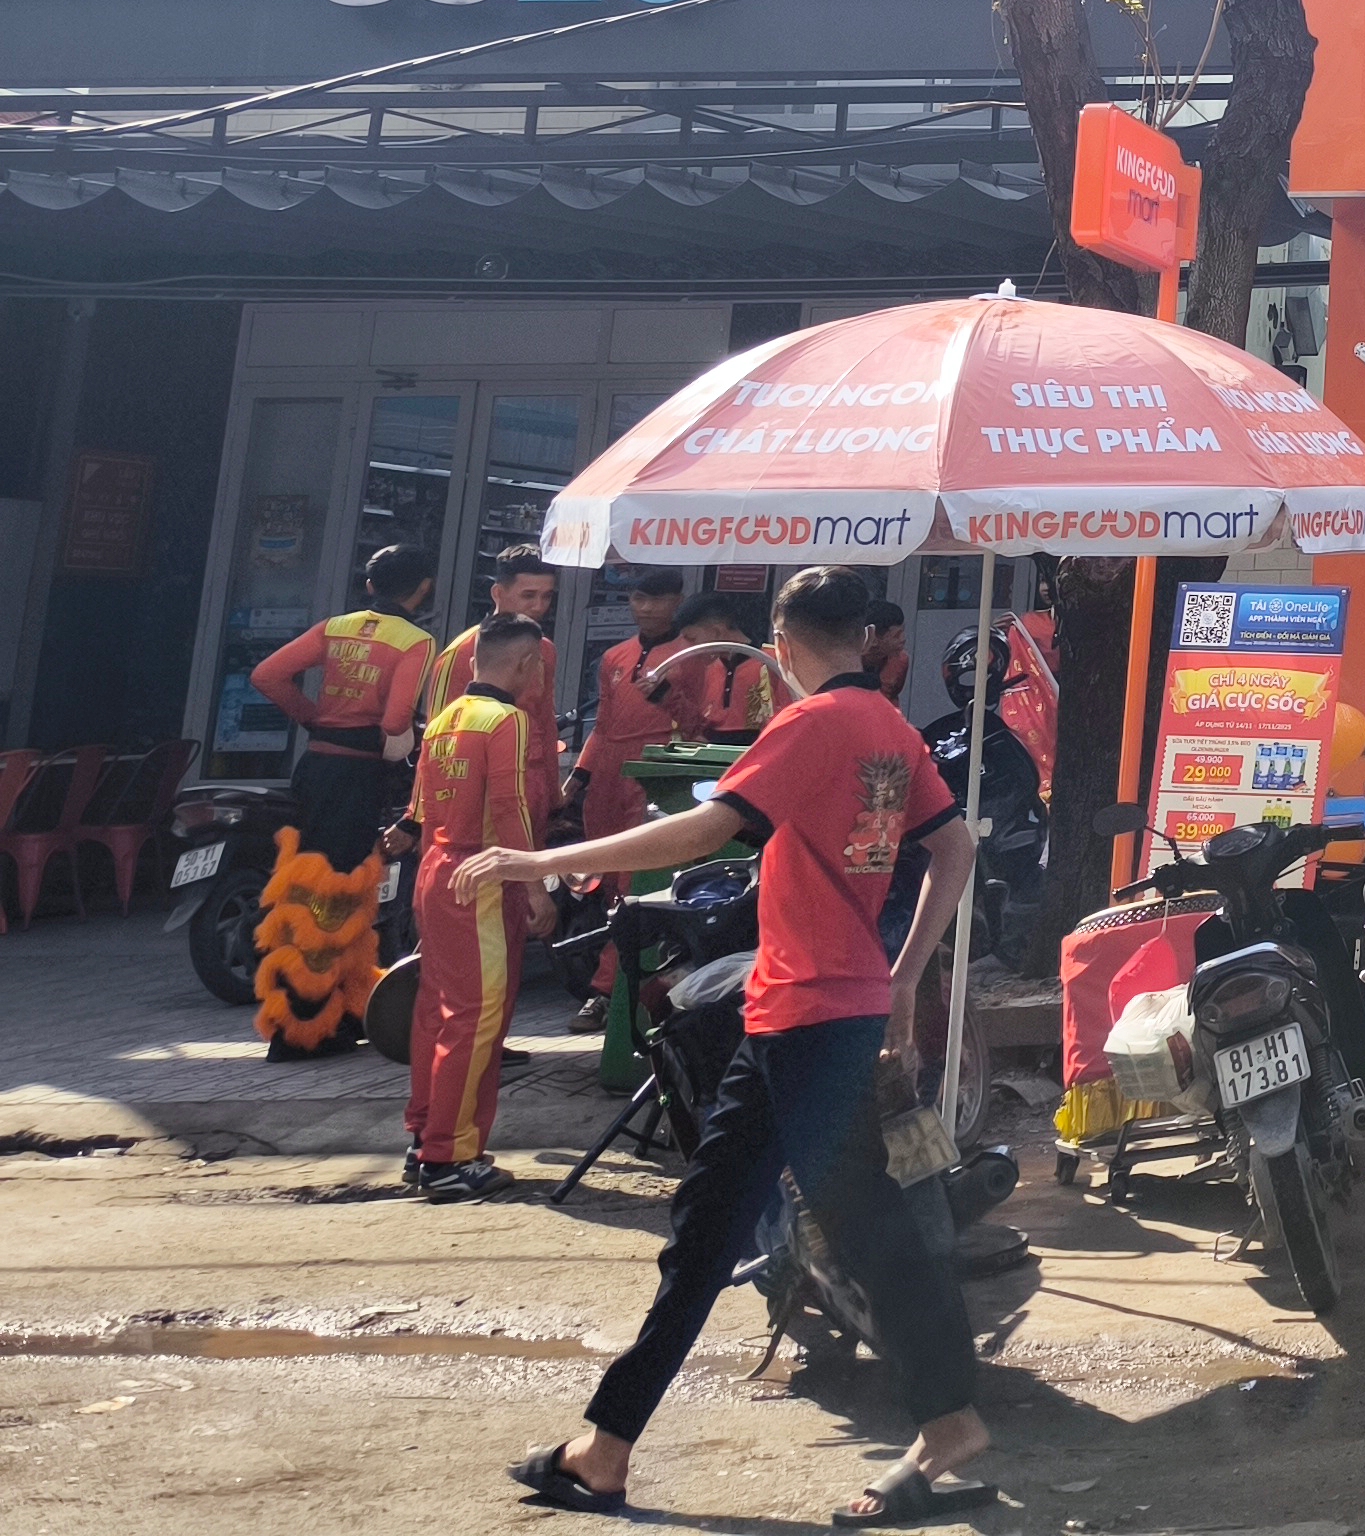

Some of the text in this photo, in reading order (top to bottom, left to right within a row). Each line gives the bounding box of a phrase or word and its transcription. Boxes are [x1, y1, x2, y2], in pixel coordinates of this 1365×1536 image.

[1116, 145, 1176, 199] KINGFOOD
[1011, 378, 1168, 412] SIÊU THỊ
[1260, 388, 1321, 414] NGON
[684, 421, 793, 455] CHẤT
[981, 417, 1222, 458] THỰC PHẨM
[629, 509, 911, 547] KINGFOODmart
[968, 504, 1259, 544] KINGFOODmart
[1250, 599, 1329, 612] TẢI OneLife
[1209, 672, 1290, 689] CHỈ 4 NGÀY
[1188, 691, 1306, 714] GIÁ CỰC SỐC
[1183, 766, 1232, 782] 29.000
[1175, 823, 1223, 839] 39.000
[1229, 1031, 1289, 1073] 81-H1
[1228, 1054, 1302, 1101] 173.81
